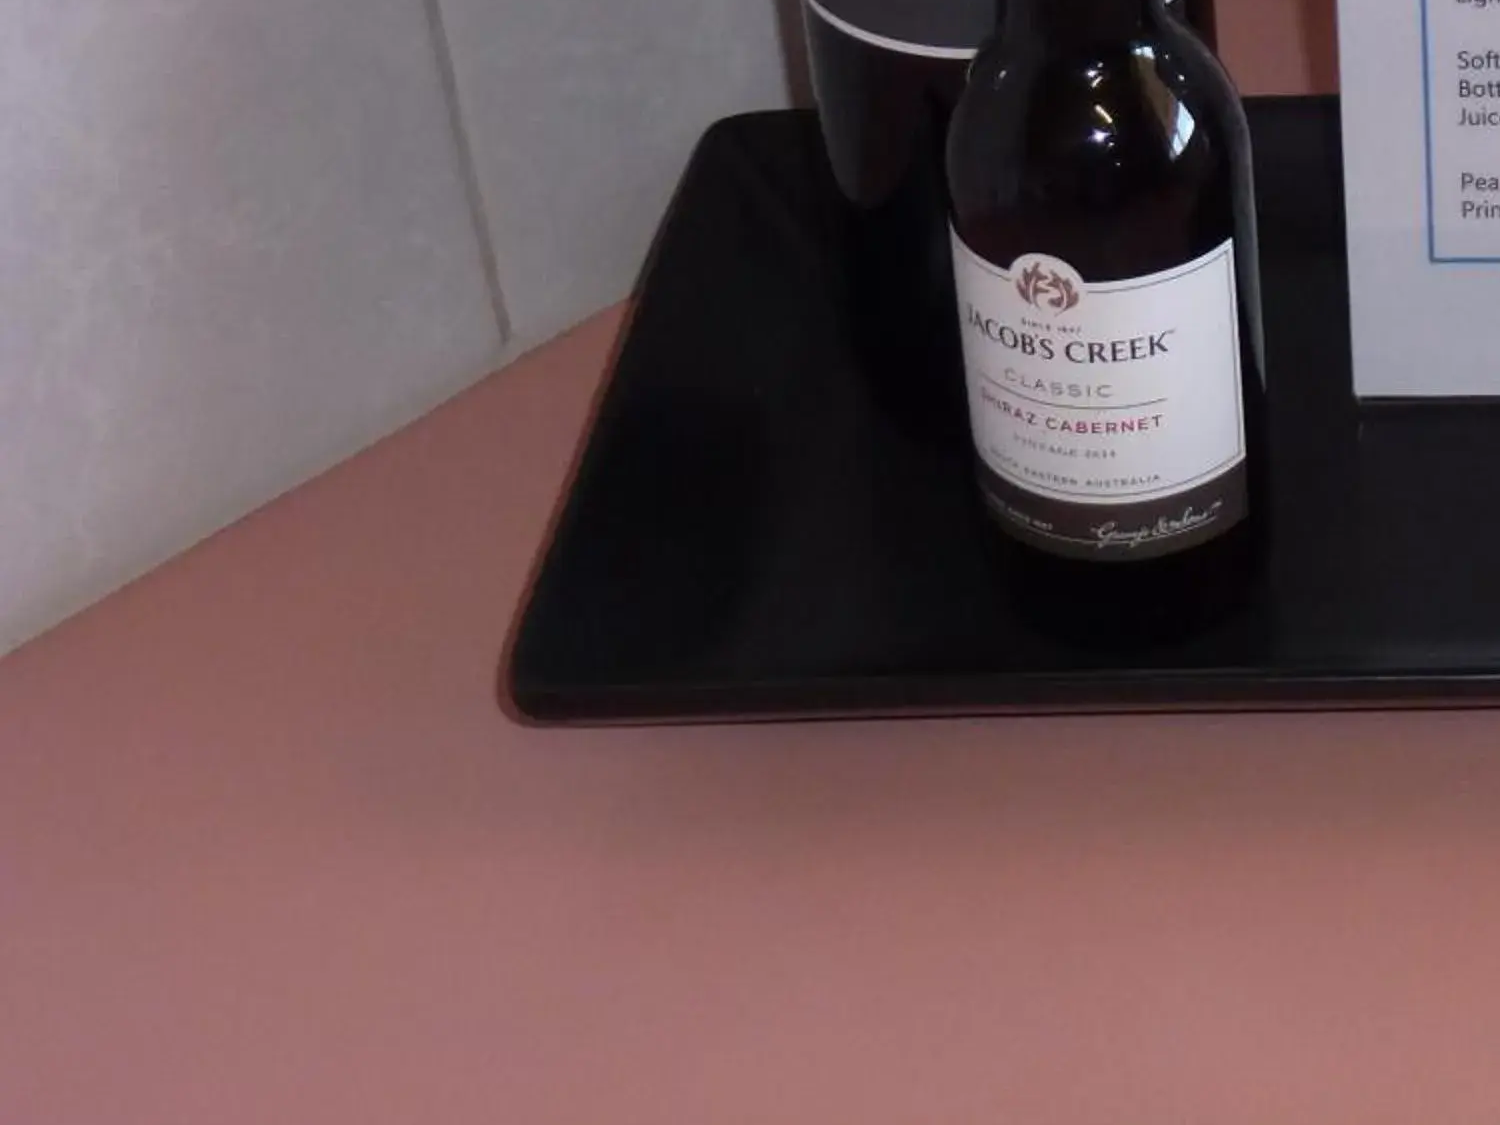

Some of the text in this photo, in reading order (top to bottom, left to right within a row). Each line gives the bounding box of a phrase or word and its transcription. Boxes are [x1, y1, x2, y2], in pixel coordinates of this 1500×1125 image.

[1458, 50, 1500, 70] Soft
[967, 302, 1168, 363] JACOB'S CREEK
[1003, 367, 1114, 399] CLASSIC
[1045, 414, 1163, 434] CABERNET
[1085, 474, 1160, 488] AUSTRALIA
